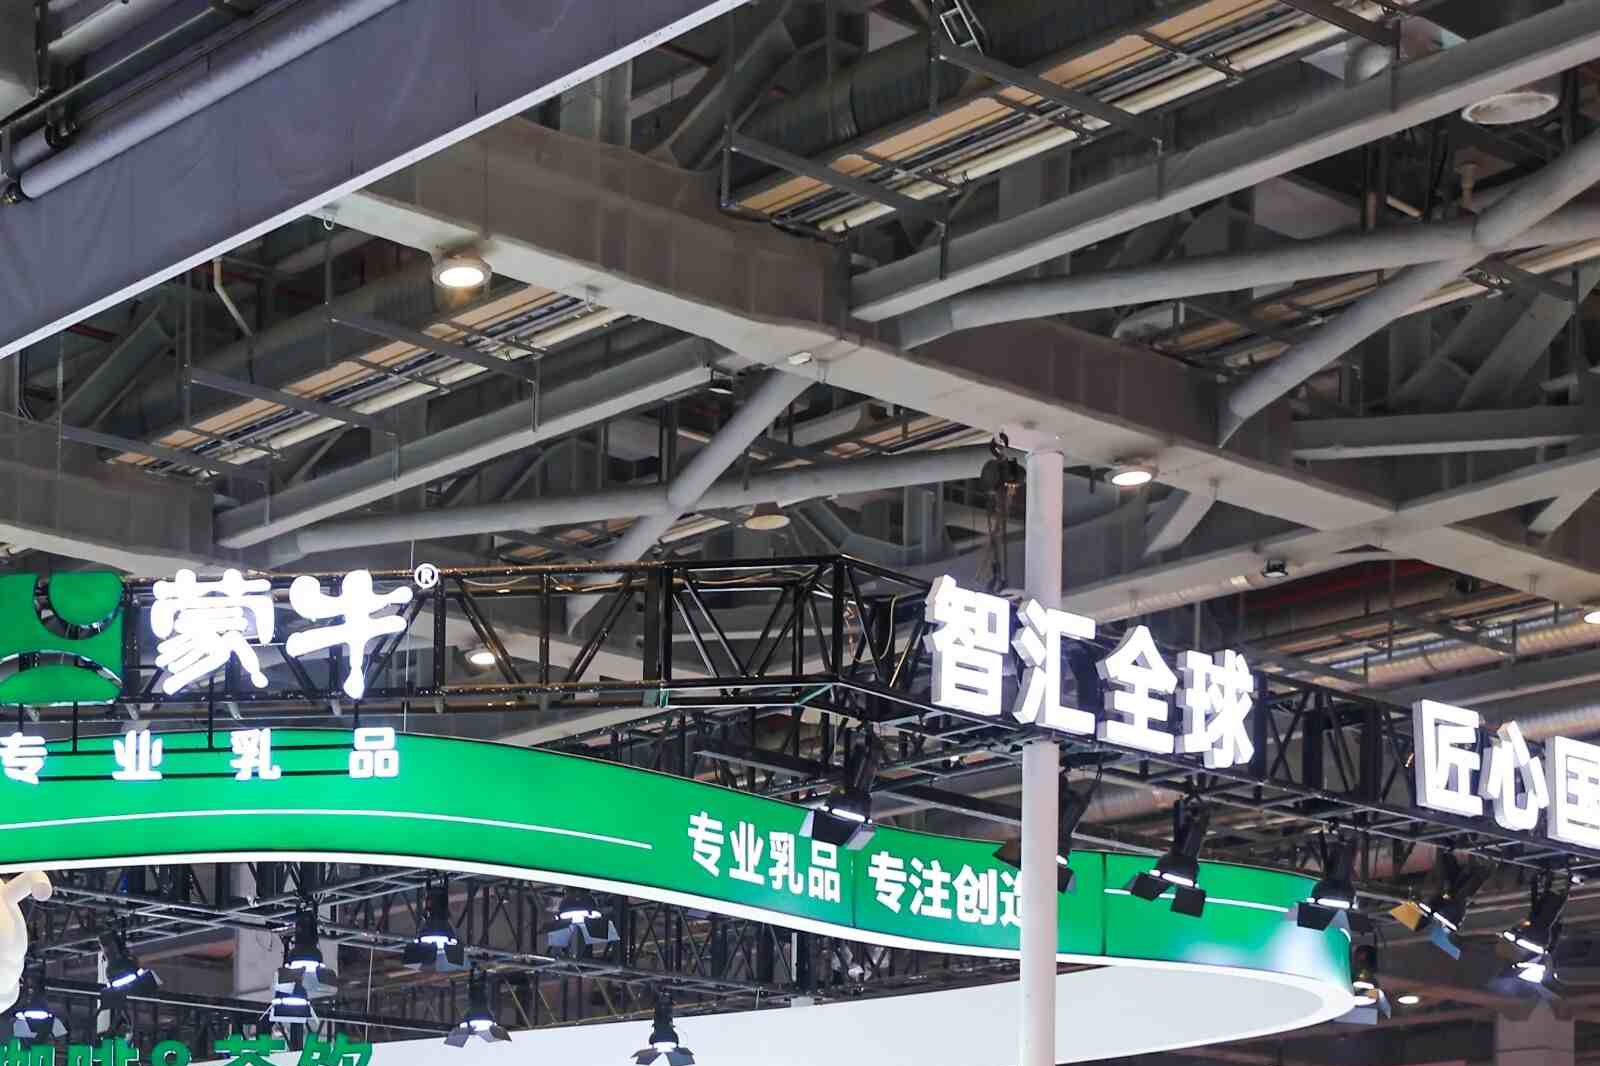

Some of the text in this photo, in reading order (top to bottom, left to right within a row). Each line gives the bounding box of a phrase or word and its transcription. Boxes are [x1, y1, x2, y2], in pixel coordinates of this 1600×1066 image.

[150, 568, 413, 699] 蒙牛
[927, 574, 1256, 768] 智汇全球
[687, 811, 841, 903] 专业乳品
